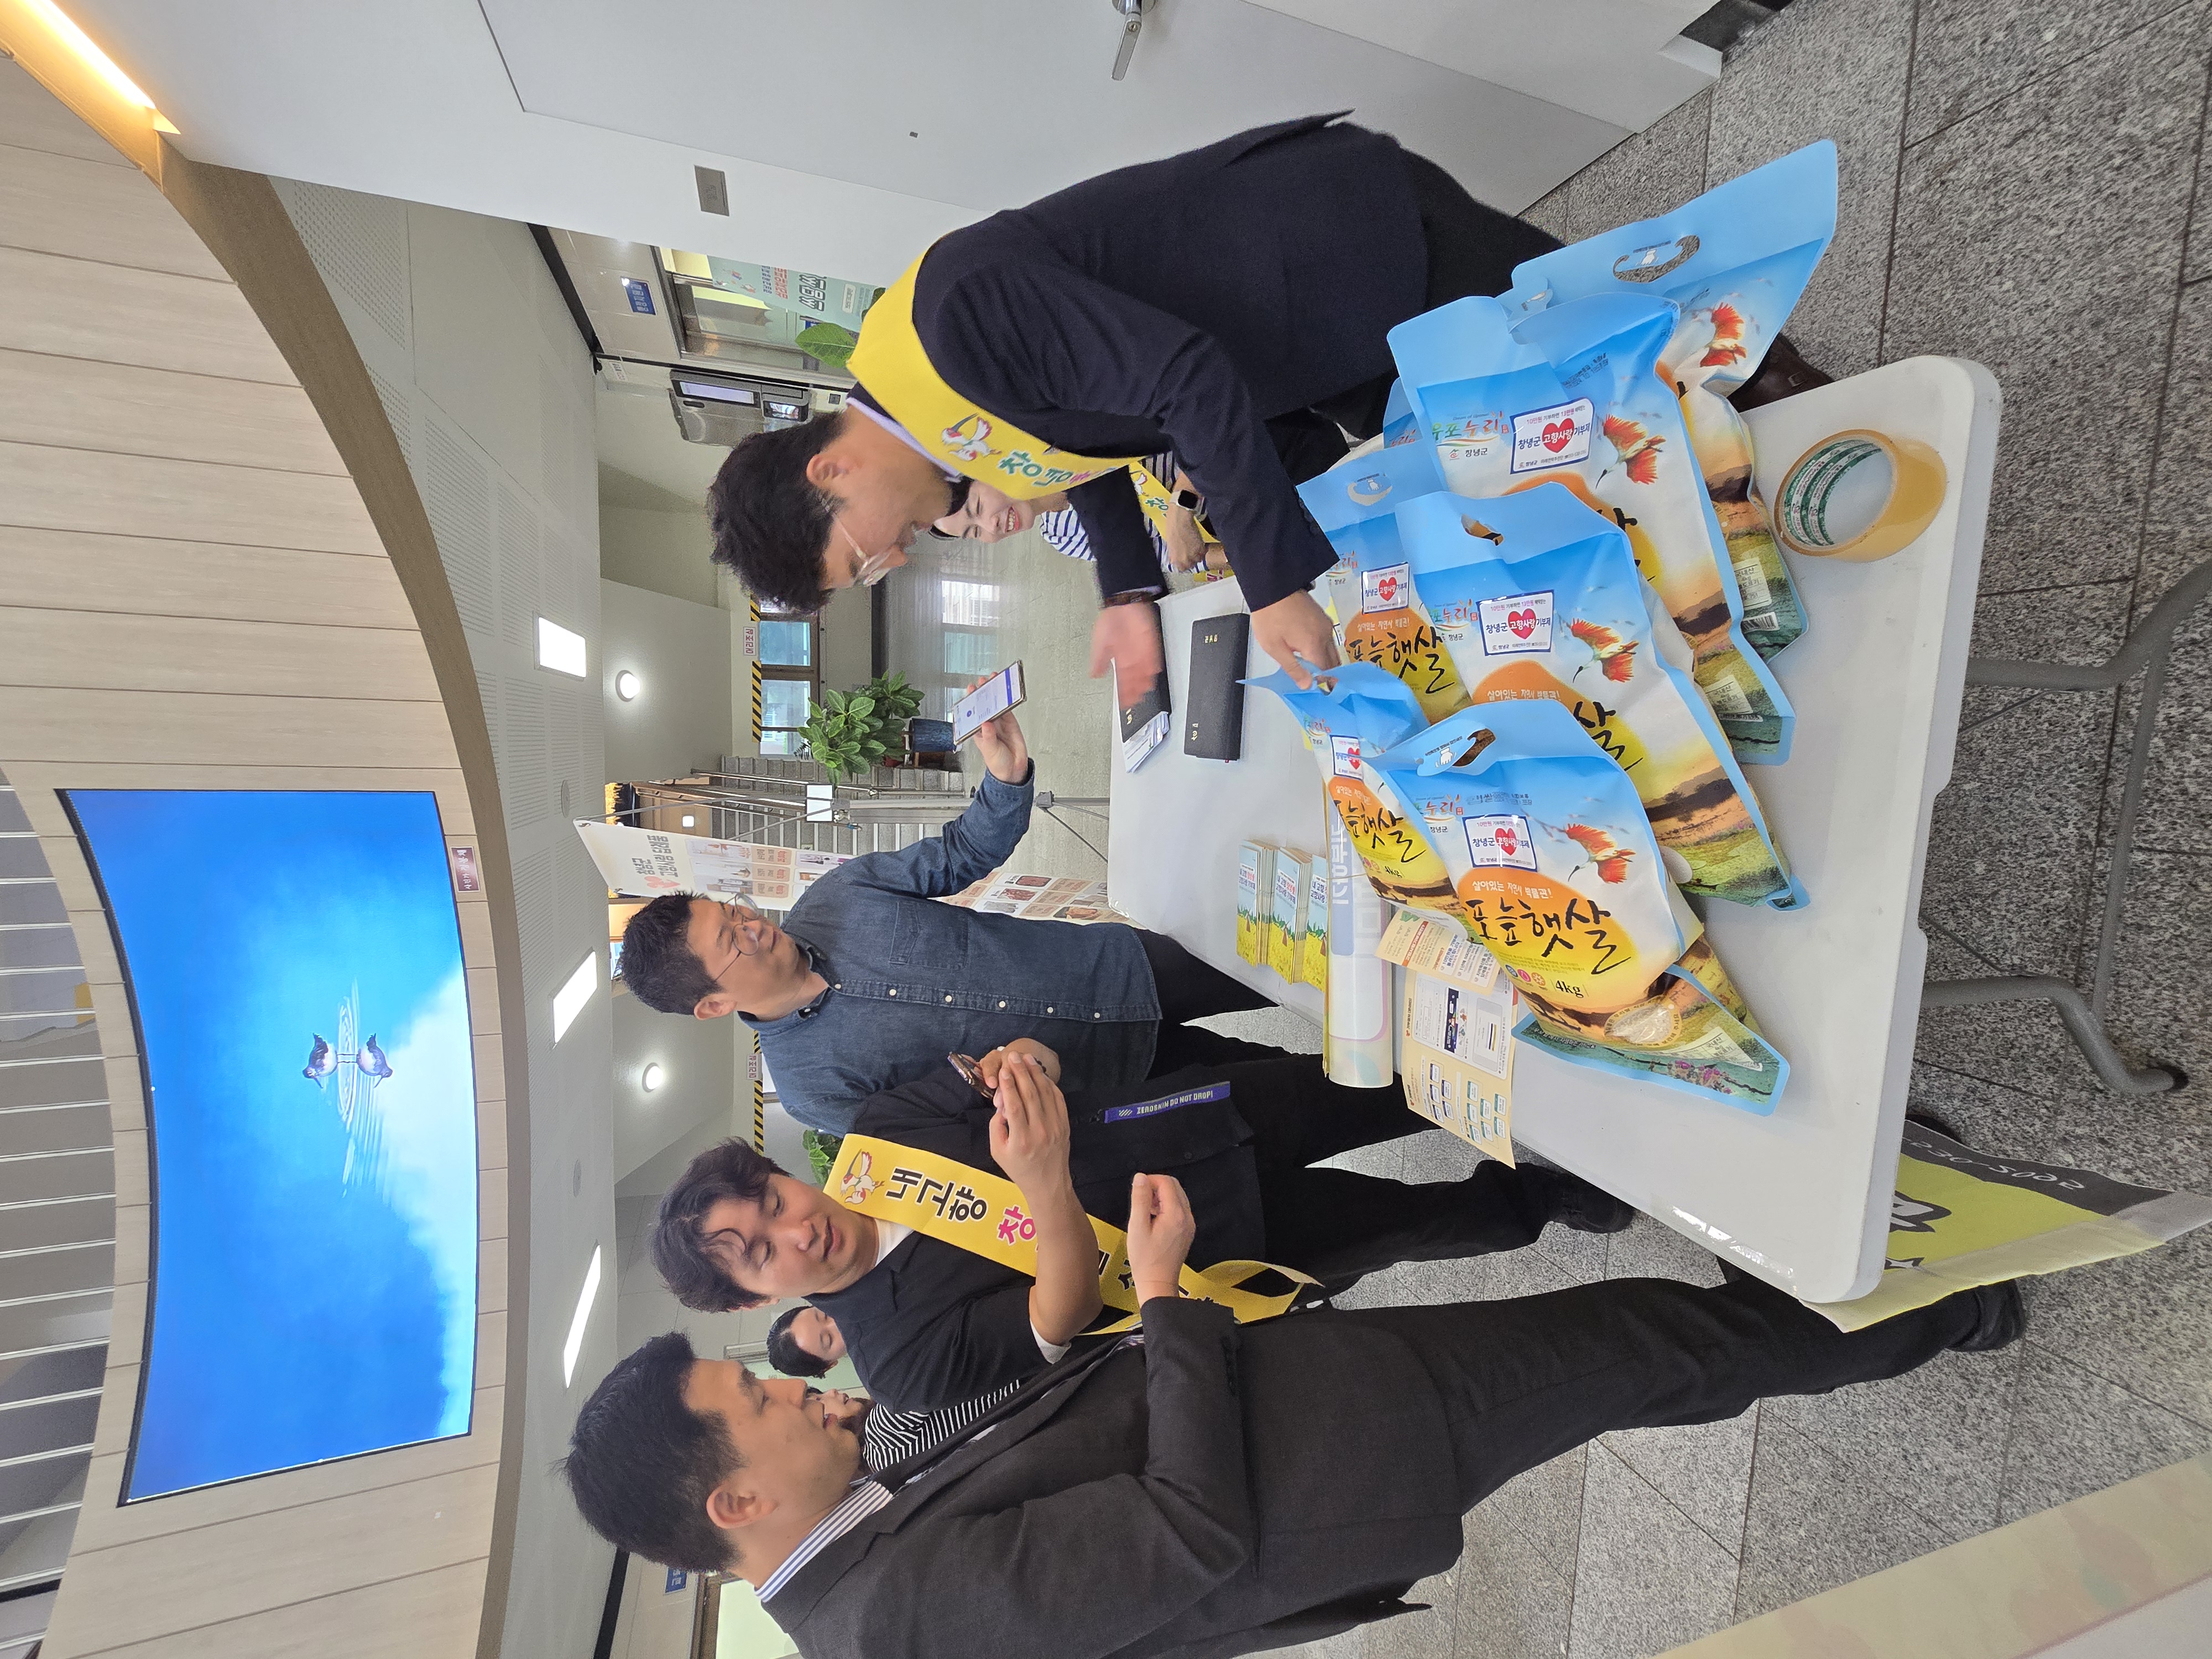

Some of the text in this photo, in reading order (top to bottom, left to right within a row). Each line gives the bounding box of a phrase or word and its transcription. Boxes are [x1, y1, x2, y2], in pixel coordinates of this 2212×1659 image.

[631, 284, 649, 311] 행정지원과
[799, 276, 827, 311] 쓰담쓰
[1527, 416, 1542, 425] 10만원
[1543, 413, 1559, 421] 기부하면
[1518, 436, 1541, 450] 창녕군
[1465, 447, 1488, 457] 창녕군
[1145, 498, 1168, 515] 창
[1735, 567, 1755, 577] 국내산
[1431, 607, 1467, 623] 포누리
[1358, 622, 1375, 632] 살아있는
[1378, 620, 1393, 629] 자연사
[1486, 623, 1508, 634] 창녕군
[1487, 690, 1517, 700] 살아있는
[1473, 838, 1495, 847] 창녕군
[646, 835, 678, 877] 고향사랑 답례품
[632, 858, 655, 875] 창녕군
[462, 874, 472, 889] 사진가
[1472, 880, 1553, 899] 살아있는 자연사 박물관!
[1464, 897, 1631, 974] 포늪햇살
[1556, 980, 1584, 998] 4kg
[748, 1055, 757, 1078] 머리조심
[1170, 1098, 1178, 1106] DO
[1180, 1093, 1192, 1103] NOT
[997, 1205, 1037, 1244] 창
